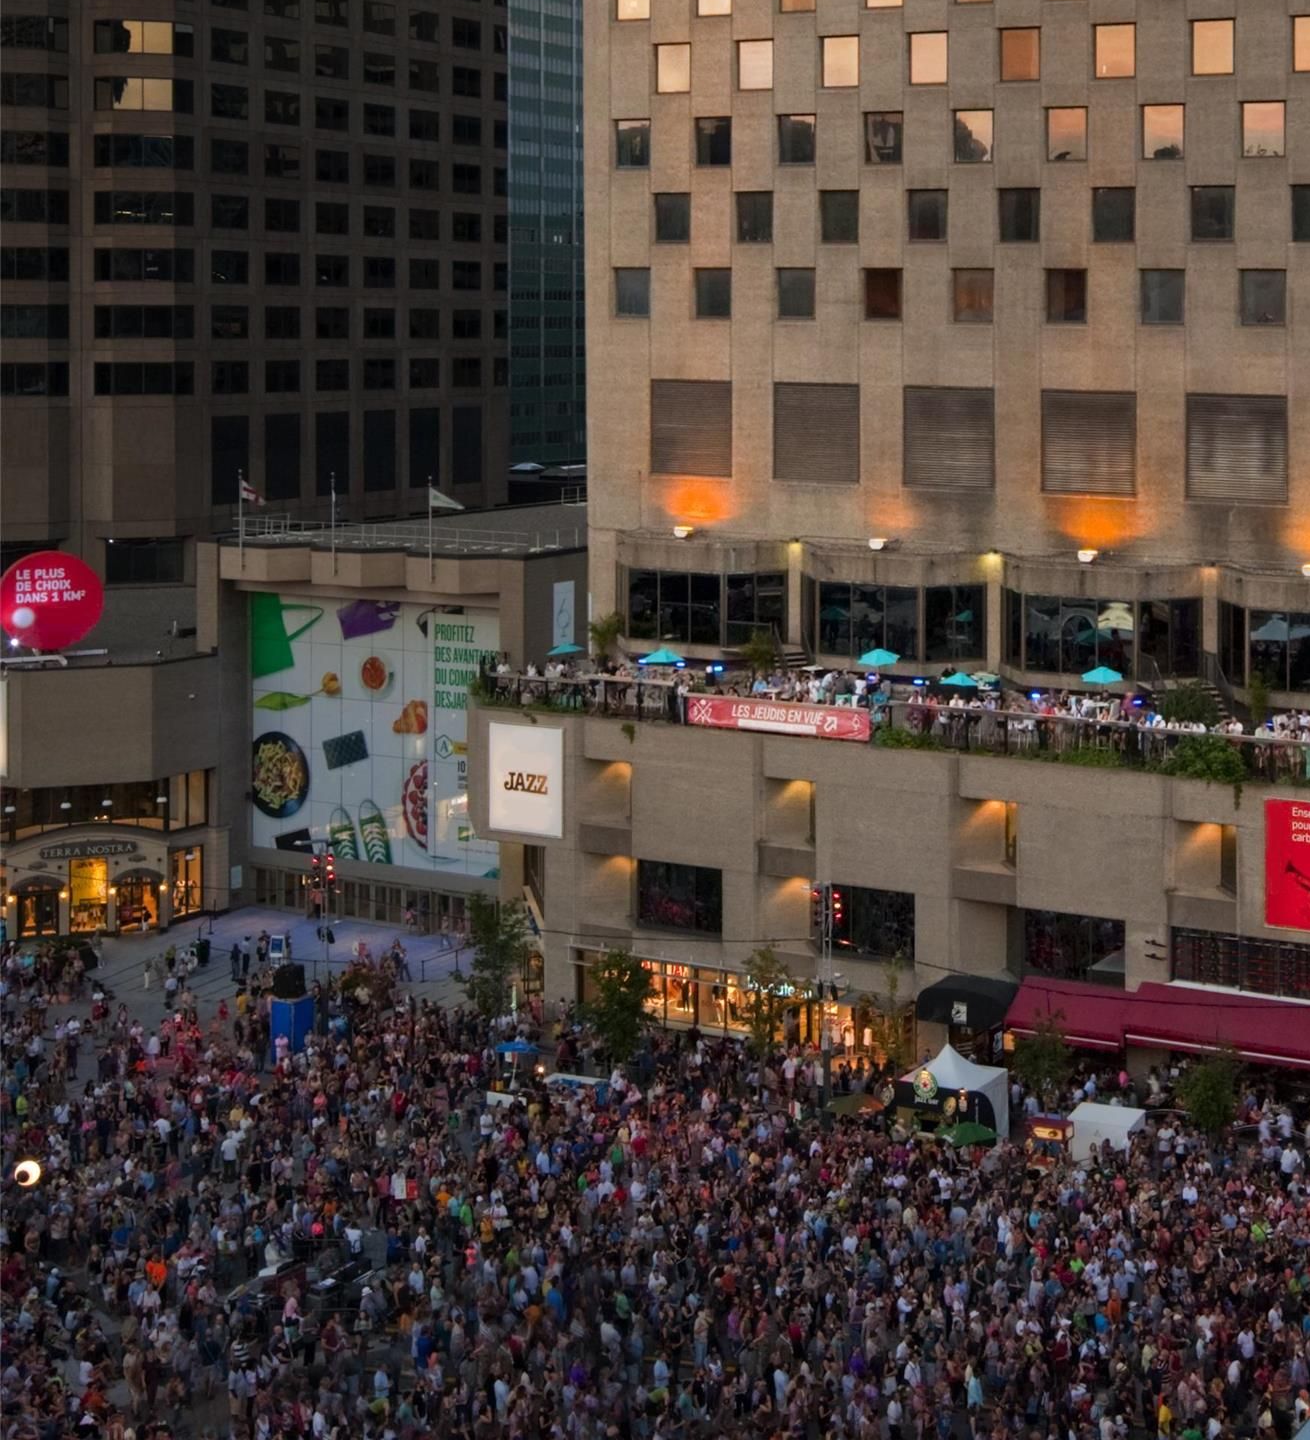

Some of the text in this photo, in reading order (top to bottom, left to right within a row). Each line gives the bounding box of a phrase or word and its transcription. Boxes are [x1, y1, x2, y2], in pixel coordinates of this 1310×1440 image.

[15, 568, 66, 580] LE PLUS
[15, 579, 72, 592] DE CHOIX
[15, 592, 49, 603] DANS
[51, 591, 60, 602] 1
[434, 624, 475, 643] PROFITEZ
[434, 646, 452, 663] DES
[434, 668, 447, 686] DU
[731, 704, 824, 725] LES JEUDIS EN VUE
[504, 771, 548, 795] JAZZ
[42, 843, 134, 859] TERRA NOSTRA
